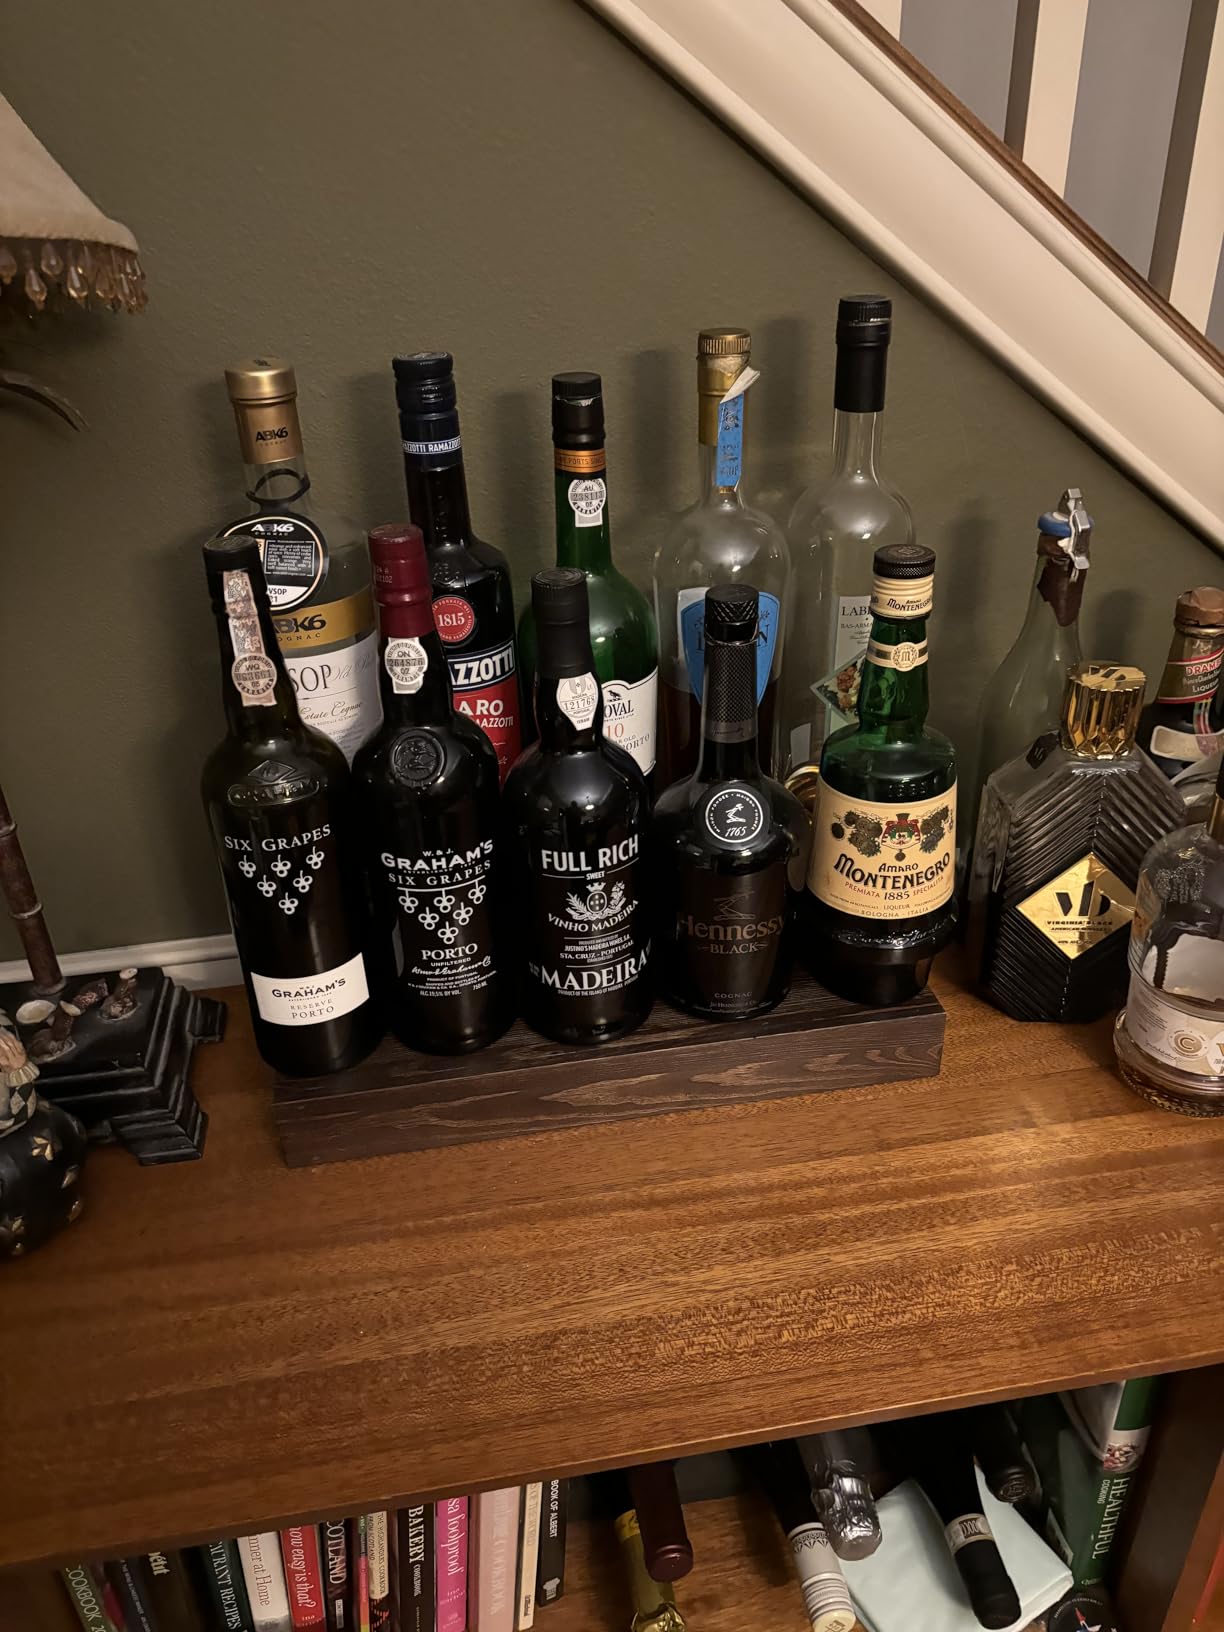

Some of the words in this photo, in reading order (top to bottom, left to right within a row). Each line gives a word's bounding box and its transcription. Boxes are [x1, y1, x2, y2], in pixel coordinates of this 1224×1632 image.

[256, 427, 288, 442] ABK6
[251, 523, 295, 533] ABK6
[276, 613, 327, 634] BK6
[438, 612, 466, 627] 1815
[288, 664, 331, 693] SOP
[459, 699, 504, 716] ARO
[603, 700, 634, 719] OVAL
[607, 723, 624, 738] 10
[224, 835, 253, 852] SIX
[260, 824, 331, 852] GRAPES
[724, 826, 748, 838] 1765
[381, 839, 494, 871] GRAHAM'S
[541, 849, 592, 872] FULL
[598, 833, 639, 869] RICH
[389, 873, 417, 886] SIX
[426, 860, 491, 886] GRAPES
[586, 871, 606, 880] SWEET
[833, 852, 950, 891] MONTENEGRO
[878, 863, 909, 873] AMARO
[844, 881, 891, 898] PREMIATA
[884, 889, 910, 901] 1885
[548, 912, 589, 933] VINHO
[591, 899, 639, 932] MADEIRA
[420, 942, 478, 961] PORTO
[710, 942, 759, 954] BLACK
[430, 957, 471, 967] UNFILTERED
[541, 948, 647, 991] MADEIRA
[272, 978, 346, 998] GRAHAM'S
[291, 998, 332, 1010] RESERVE
[292, 1006, 334, 1019] PORTO
[550, 1479, 560, 1501] BOOK
[550, 1500, 559, 1511] OF
[549, 1512, 559, 1538] ALBERT
[1092, 1476, 1129, 1560] HEALTHFUL
[408, 1504, 425, 1563] BAKERY
[254, 1561, 265, 1575] at
[287, 1549, 306, 1571] easy
[295, 1568, 312, 1581] is
[413, 1564, 422, 1597] COOKBOOK
[258, 1574, 273, 1607] Home
[296, 1581, 317, 1608] that?
[219, 1587, 242, 1631] RECIPES
